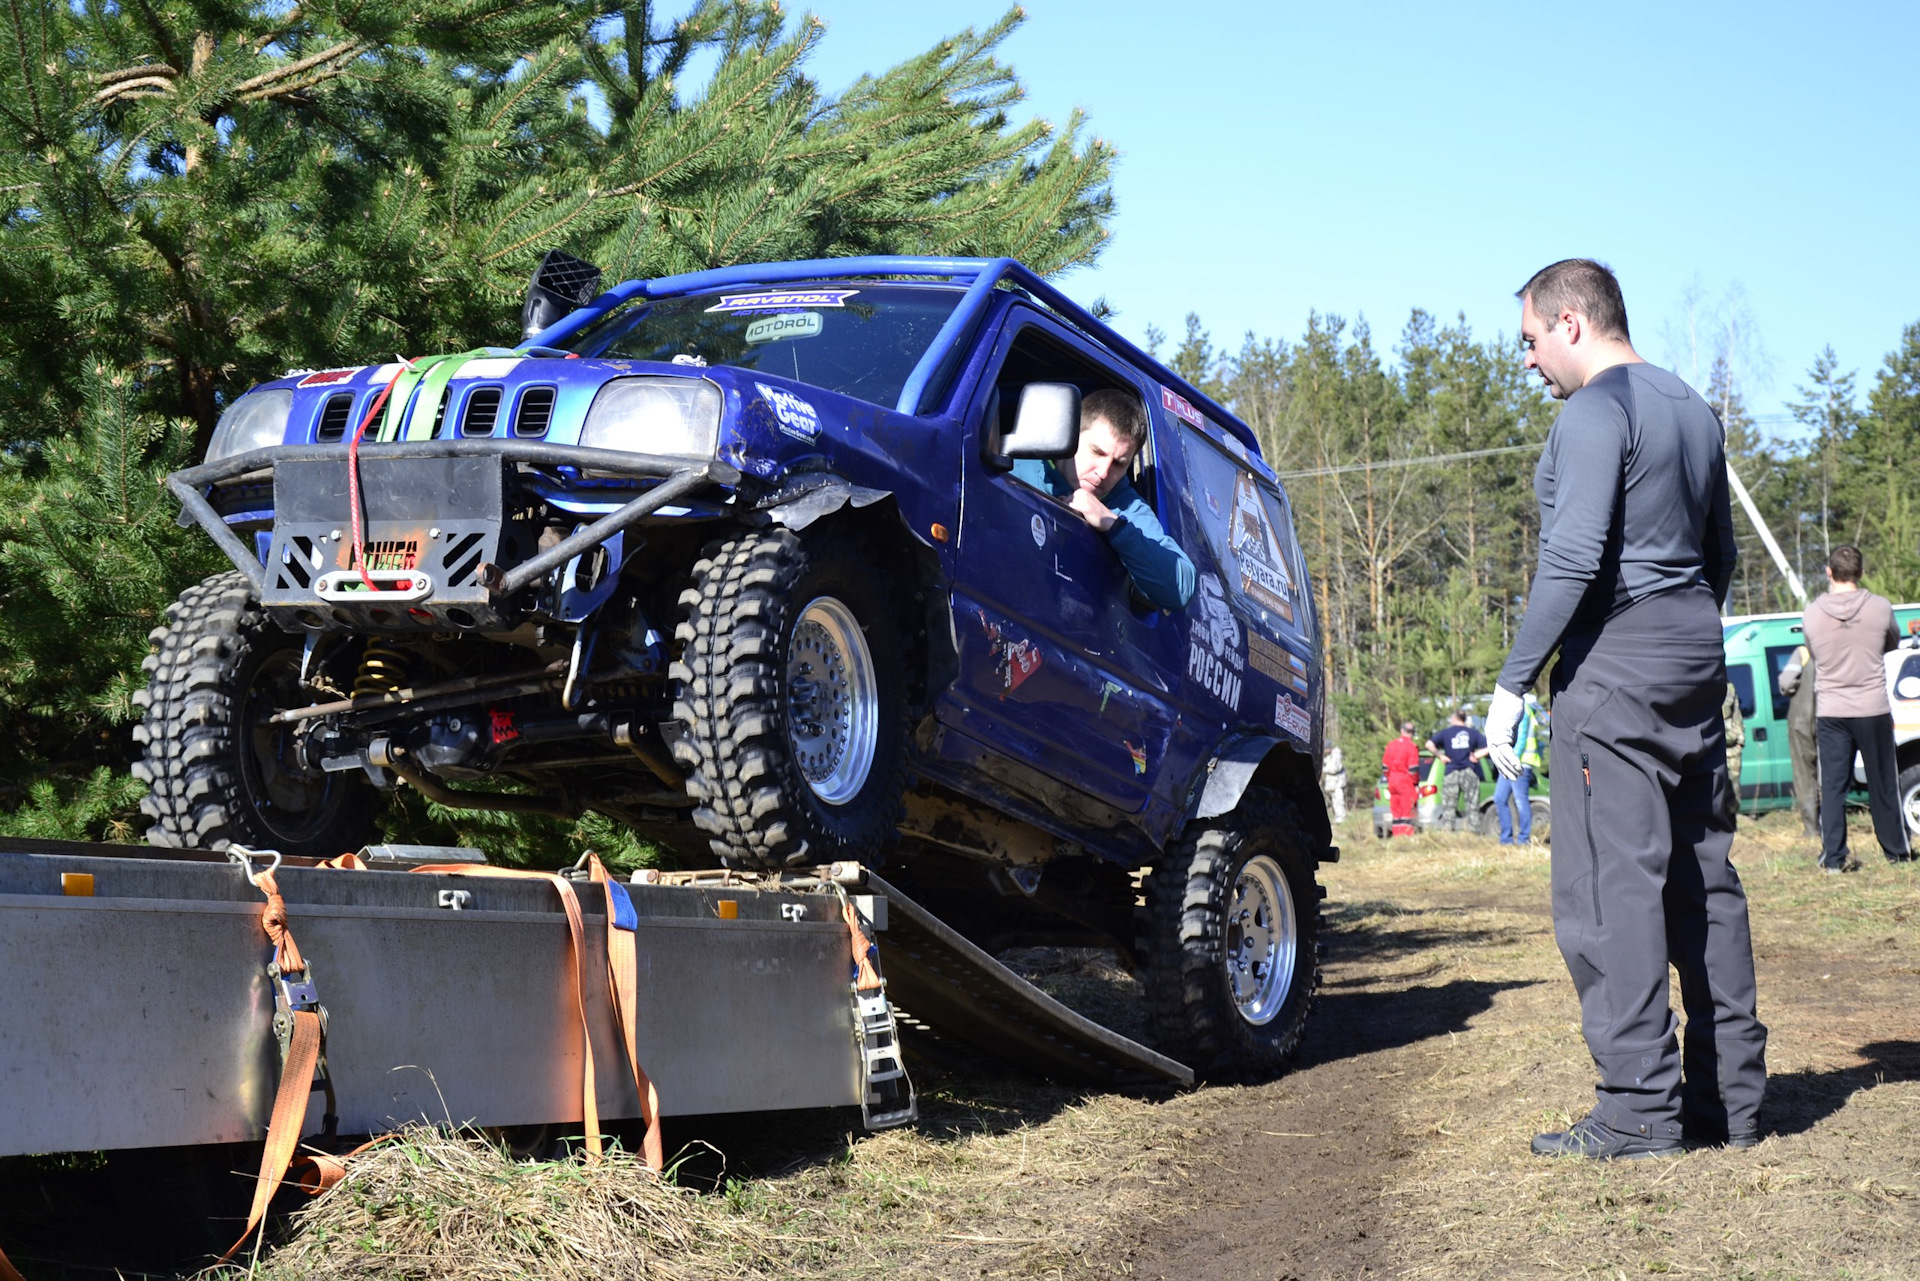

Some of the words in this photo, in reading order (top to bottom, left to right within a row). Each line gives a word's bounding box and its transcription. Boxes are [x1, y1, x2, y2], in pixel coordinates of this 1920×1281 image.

[728, 294, 831, 306] RAVENOL
[757, 384, 817, 418] Motive
[1176, 400, 1202, 425] PLUS
[776, 403, 816, 435] Gear
[1224, 645, 1244, 672] РЕЙДЫ
[1188, 642, 1242, 712] РОССИИ
